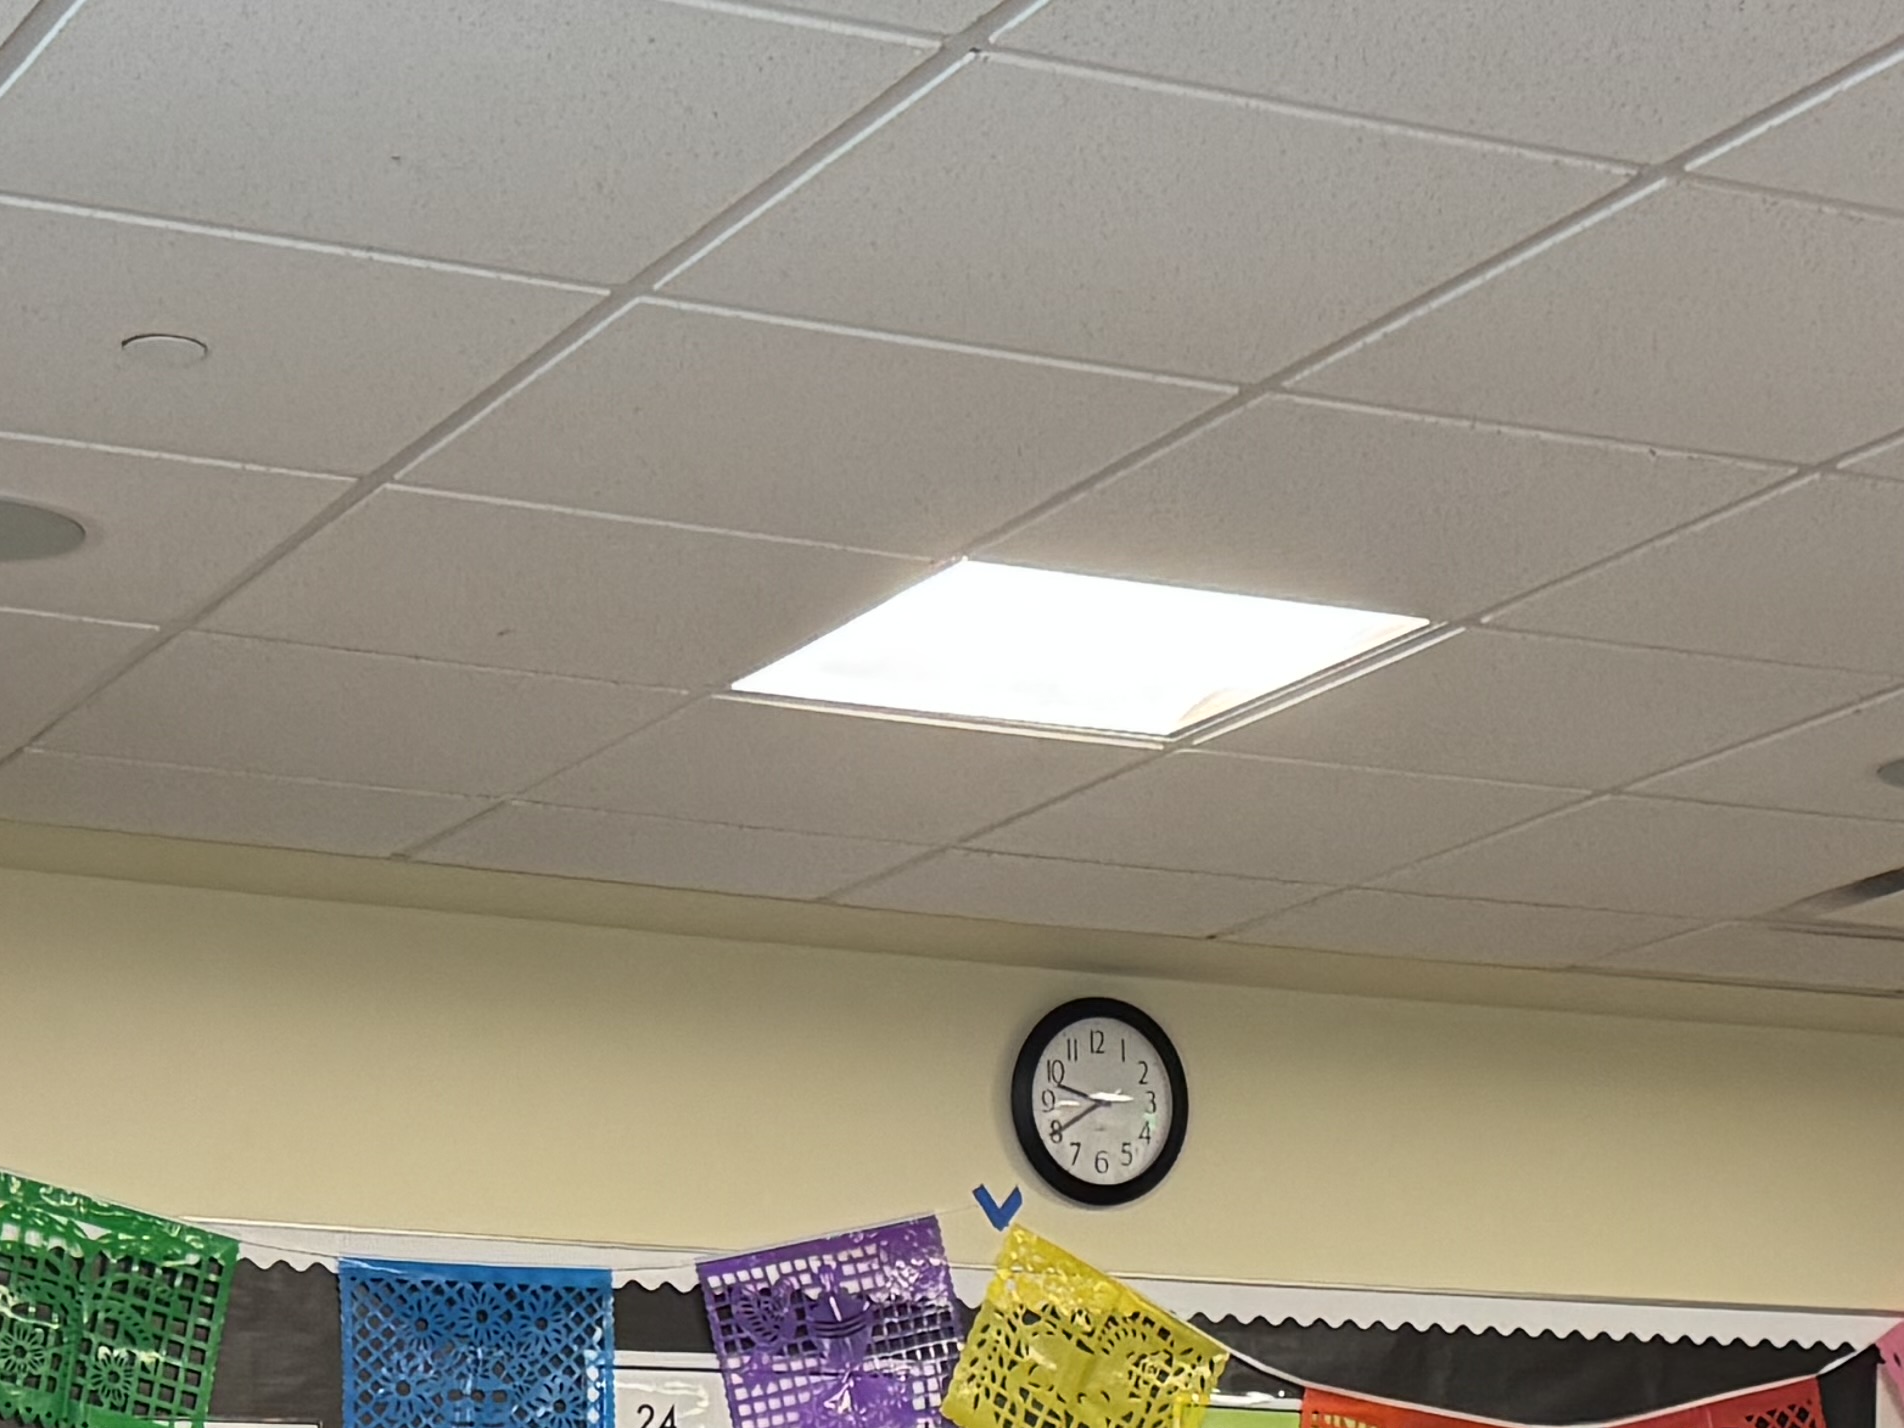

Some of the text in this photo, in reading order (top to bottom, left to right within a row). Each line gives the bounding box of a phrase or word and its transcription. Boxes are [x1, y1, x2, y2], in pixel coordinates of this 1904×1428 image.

[1066, 1038, 1078, 1062] 11
[1089, 1029, 1105, 1054] 12
[1120, 1038, 1126, 1062] 1
[1046, 1060, 1065, 1085] 10
[1138, 1061, 1149, 1085] 2
[1042, 1089, 1056, 1112] 9
[1145, 1091, 1157, 1114] 3
[1050, 1120, 1063, 1143] 8
[1138, 1121, 1151, 1143] 4
[1069, 1142, 1081, 1166] 7
[1094, 1150, 1109, 1174] 6
[1121, 1142, 1133, 1166] 5
